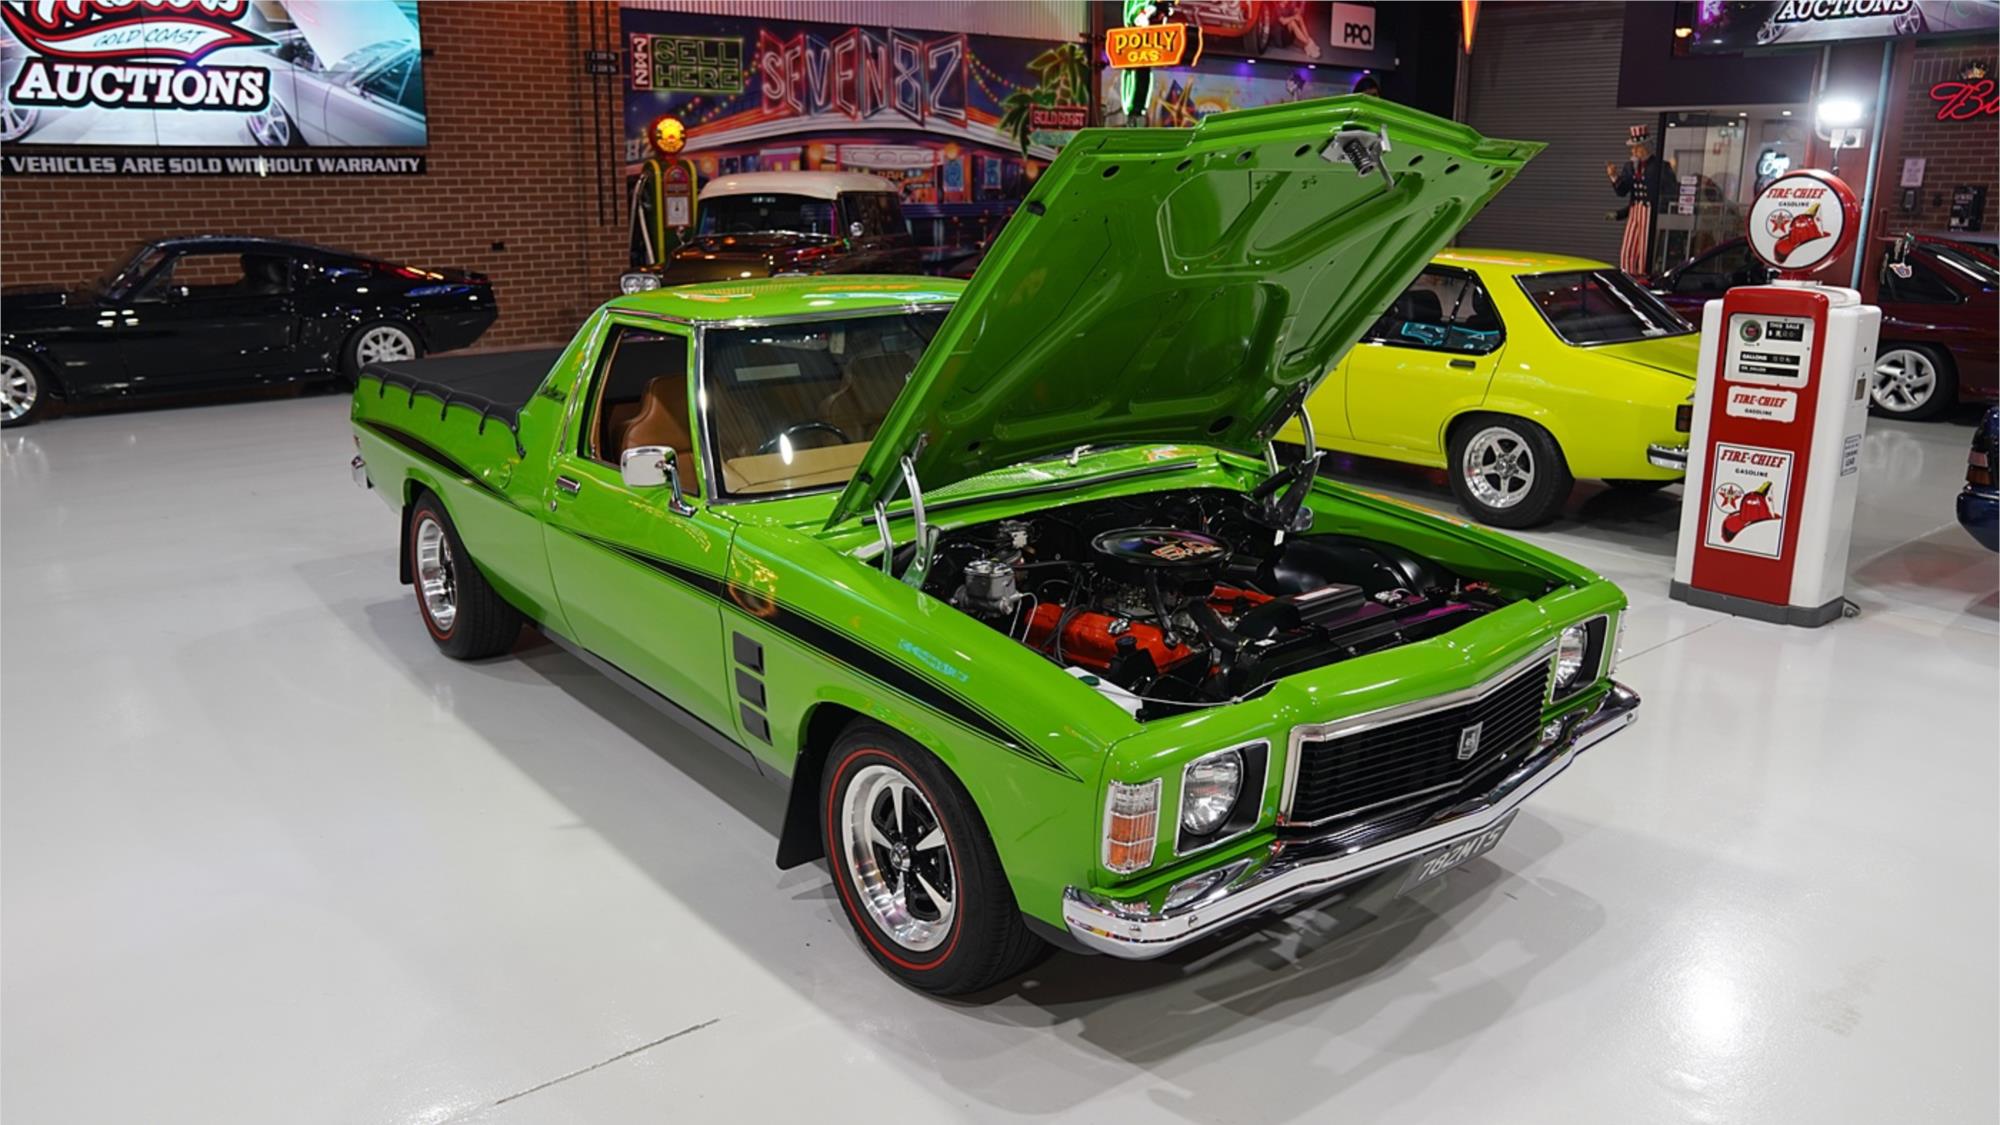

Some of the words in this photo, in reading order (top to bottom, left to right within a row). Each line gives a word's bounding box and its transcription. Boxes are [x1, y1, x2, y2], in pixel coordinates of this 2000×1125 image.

[145, 28, 207, 44] COAST
[1115, 31, 1175, 54] POLLY
[1343, 22, 1372, 46] PPQ
[654, 39, 738, 66] SELL
[1127, 51, 1160, 62] GAS
[16, 62, 266, 107] AUCTIONS
[654, 64, 739, 89] HERE
[9, 156, 116, 174] VEHICLES
[121, 158, 166, 174] ARE
[168, 157, 222, 174] SOLD
[225, 157, 314, 174] WITHOUT
[317, 157, 421, 174] WARRANTY
[1766, 187, 1828, 199] FIRE-CHIEF
[1733, 393, 1787, 408] FIRE-CHIEF
[1744, 408, 1773, 416] GASOLINE
[1720, 449, 1787, 468] FIRE-CHIEF
[1734, 467, 1769, 477] GASOLINE
